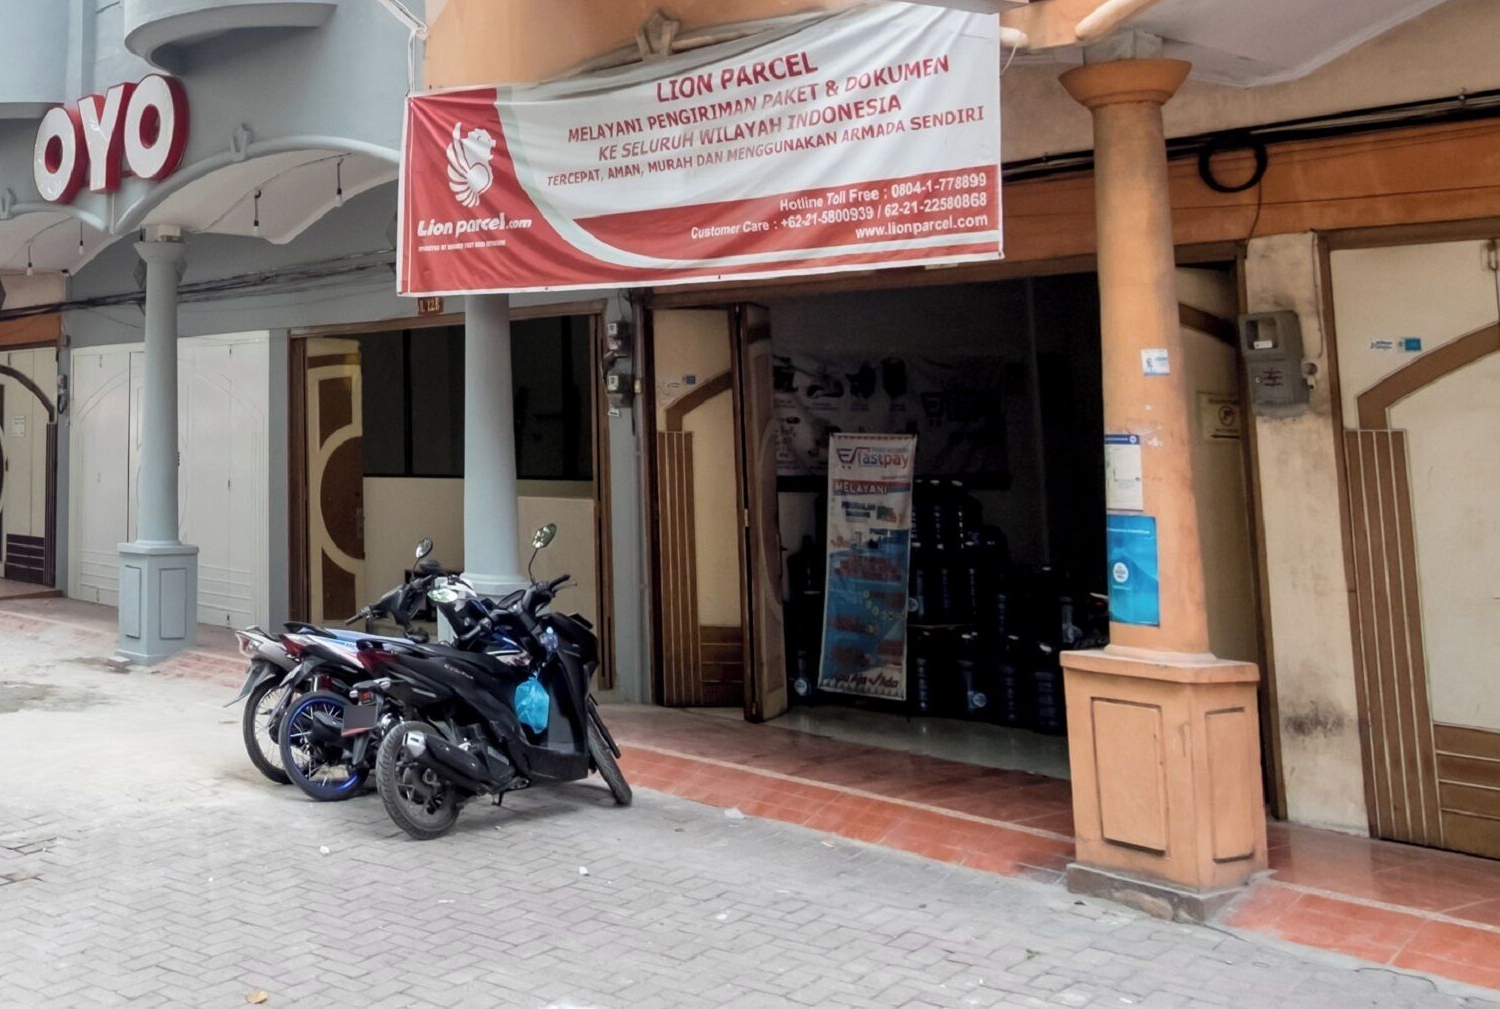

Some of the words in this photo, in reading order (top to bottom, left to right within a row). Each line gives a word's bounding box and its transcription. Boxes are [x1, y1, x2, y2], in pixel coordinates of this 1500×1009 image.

[567, 117, 644, 143] MELAYANI
[648, 96, 757, 130] PENGIRIMAN
[761, 82, 819, 109] PAKET
[825, 80, 839, 97] &
[845, 54, 949, 92] DOKUMEN
[657, 72, 713, 103] LION
[720, 51, 818, 90] PARCEL
[34, 73, 188, 203] OYO
[547, 169, 604, 187] TERCEPAT,
[607, 163, 644, 180] AMAN,
[648, 156, 693, 174] MURAH
[696, 150, 723, 167] DAN
[726, 131, 837, 163] MENGGUNAKAN
[841, 119, 905, 143] ARMADA
[910, 105, 984, 131] SENDIRI
[599, 144, 618, 161] KE
[621, 132, 694, 158] SELURUH
[699, 117, 782, 146] WILAYAH
[787, 94, 901, 131] INDONESIA
[691, 223, 741, 240] Customer
[743, 220, 770, 233] Care
[780, 207, 875, 230] +62-21-5800939
[884, 192, 987, 218] 62-21-22580868
[780, 197, 823, 212] Hotline
[826, 192, 846, 206] Toll
[849, 189, 879, 203] Free
[891, 172, 987, 198] 0804-1-778899
[417, 219, 453, 237] Lion
[455, 212, 532, 238] parcel.com
[855, 213, 988, 240] www.lionparcel.com
[857, 448, 909, 469] fastpay
[835, 481, 887, 494] MELAYANI
